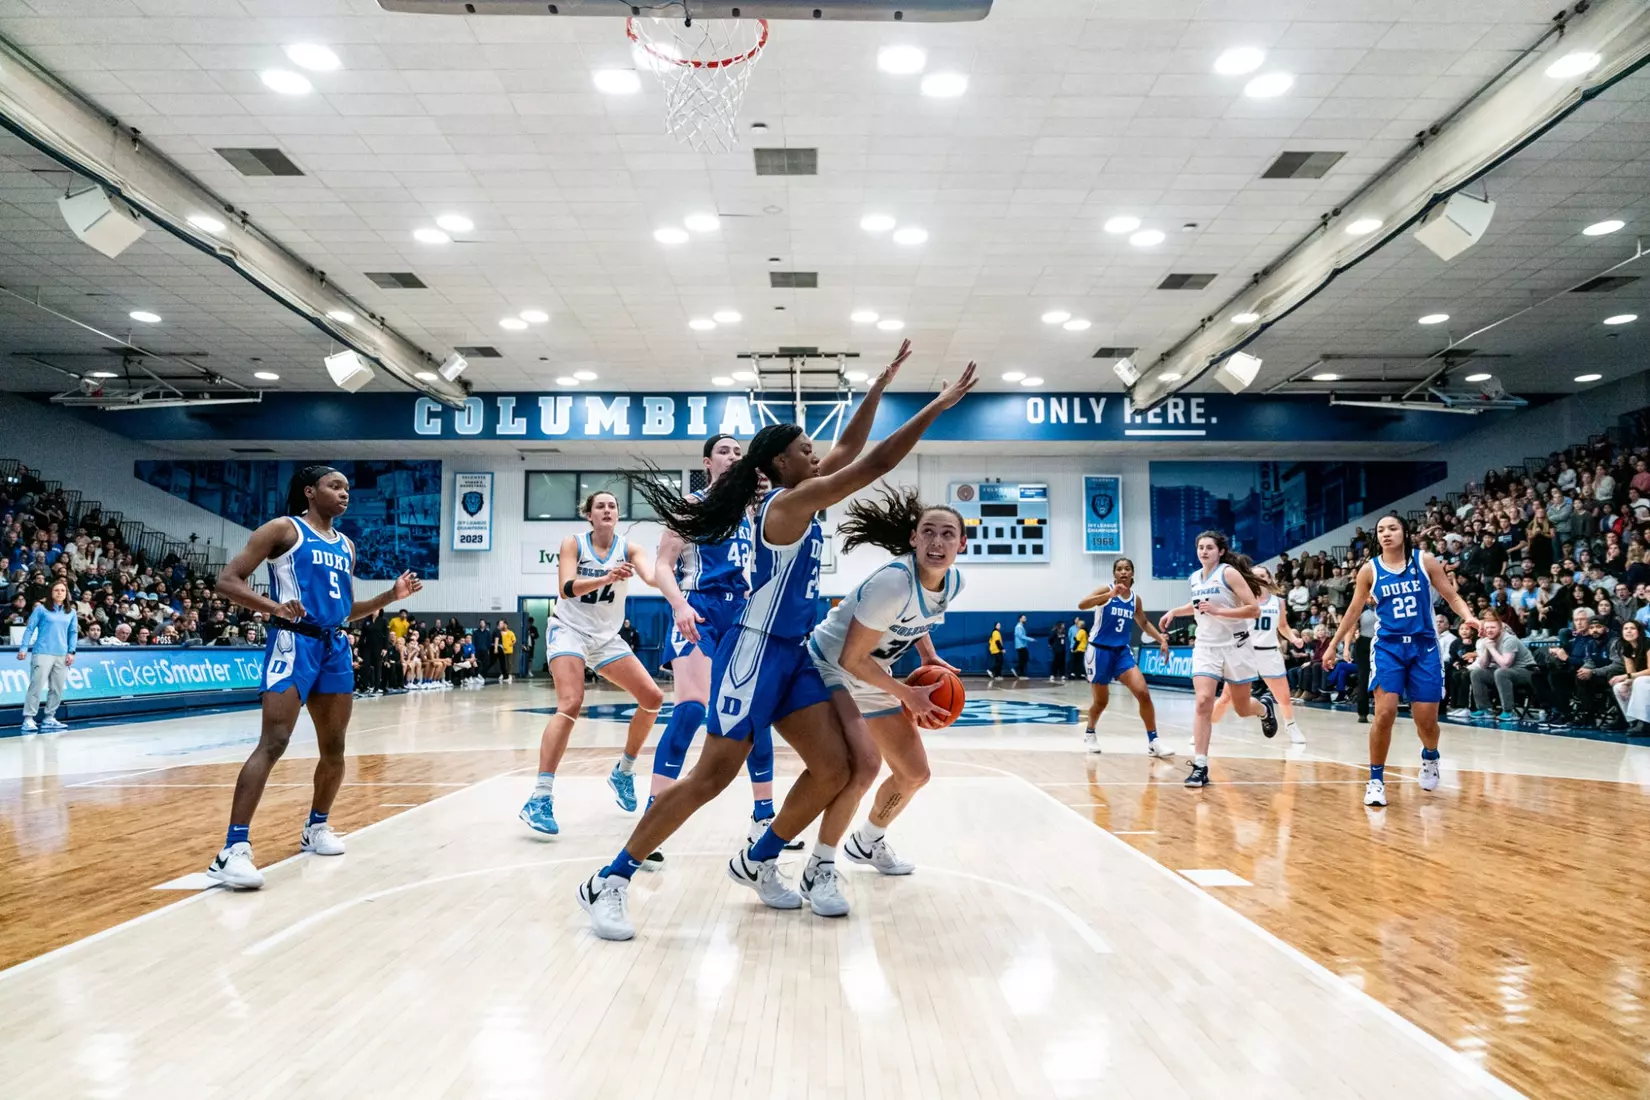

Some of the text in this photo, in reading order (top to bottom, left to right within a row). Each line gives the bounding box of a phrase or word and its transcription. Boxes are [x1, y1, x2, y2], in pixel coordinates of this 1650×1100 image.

[413, 396, 756, 436] COLUMBIA
[1026, 396, 1107, 424] ONLY
[460, 534, 483, 544] 2023
[1092, 537, 1114, 546] 1968
[727, 542, 750, 567] 42
[329, 571, 341, 599] 5
[1381, 580, 1421, 597] DUKE
[1111, 606, 1134, 619] DUKE
[1392, 595, 1418, 619] 22
[1115, 618, 1125, 632] 3
[100, 658, 232, 688] TicketSmarter
[271, 660, 287, 674] D
[721, 696, 743, 716] D
